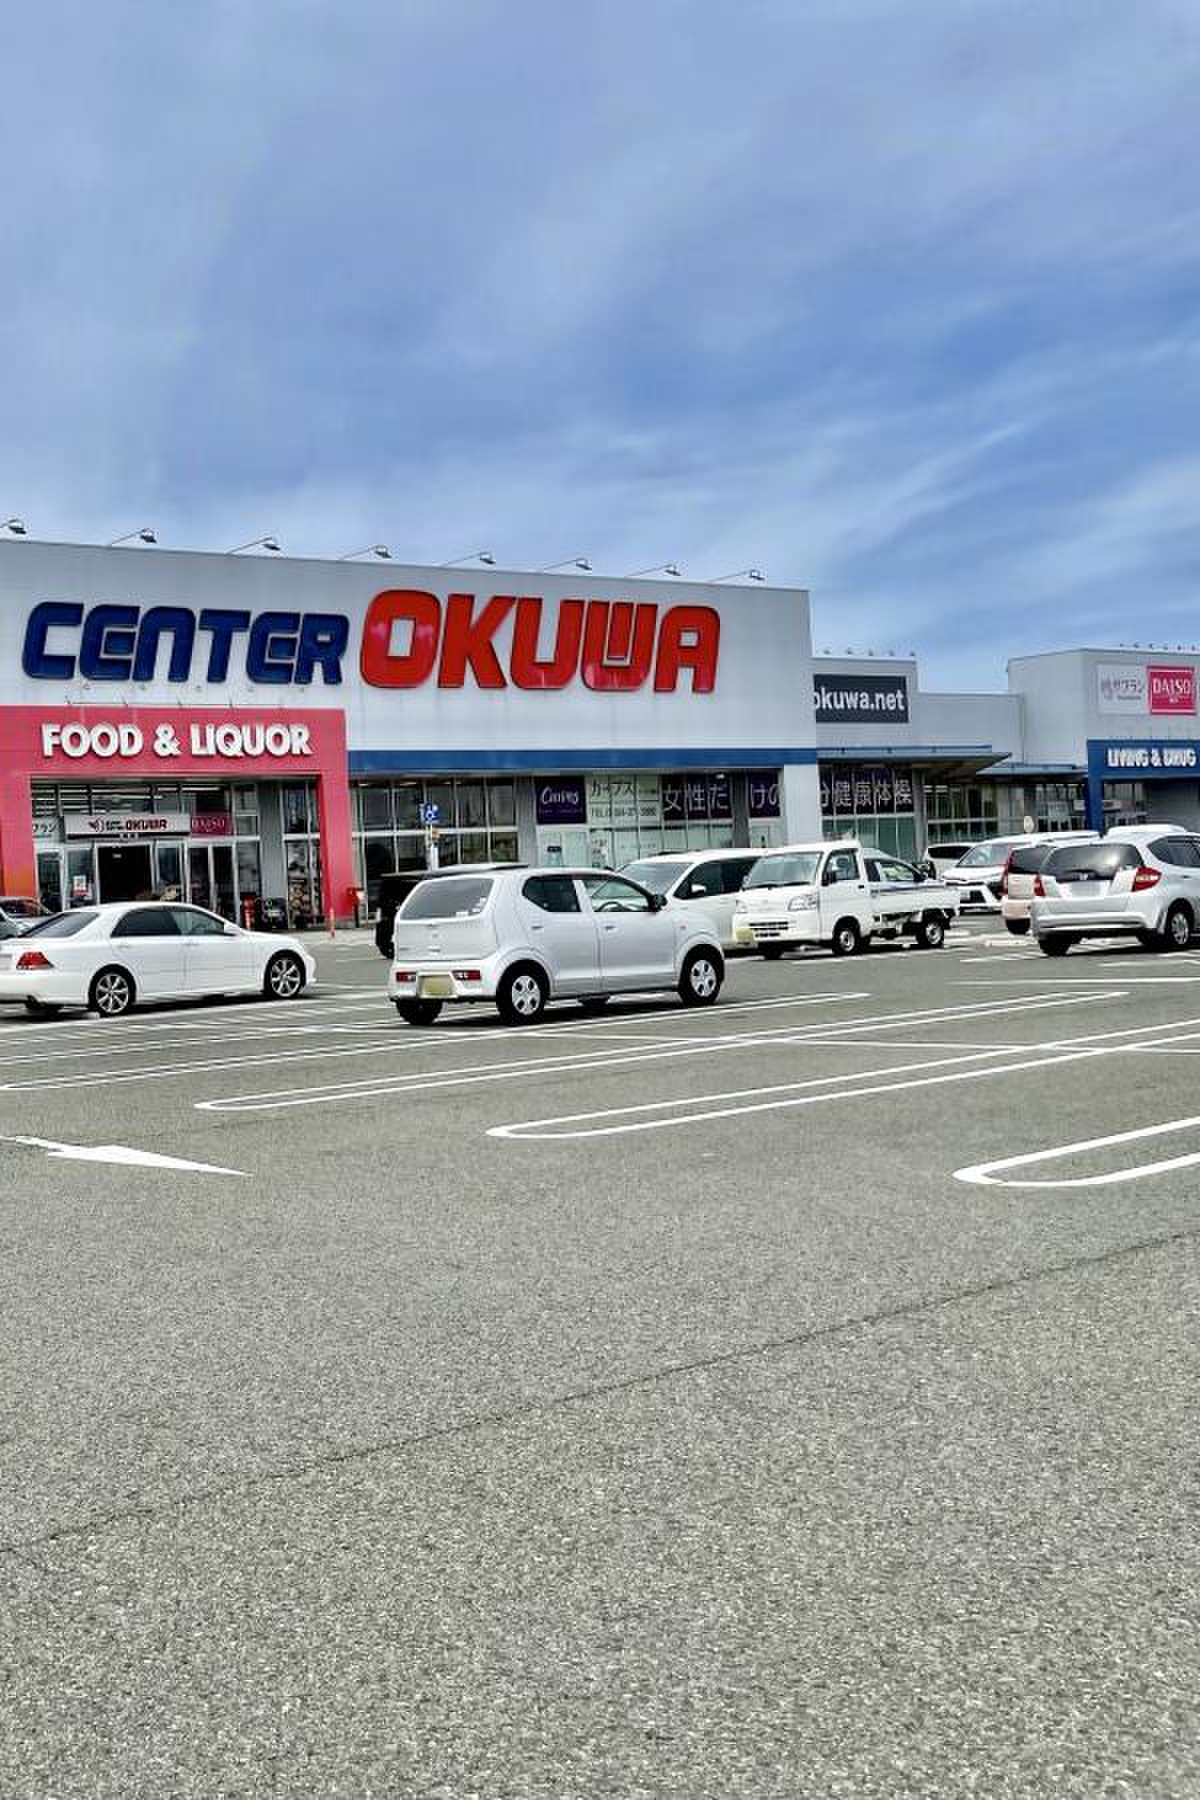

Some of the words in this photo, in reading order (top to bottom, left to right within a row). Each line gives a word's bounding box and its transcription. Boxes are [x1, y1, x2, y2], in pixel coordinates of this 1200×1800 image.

[22, 601, 349, 685] CENTER
[360, 589, 721, 694] OKUWA
[814, 686, 905, 711] okuwa.net
[1152, 678, 1191, 696] DAISO
[41, 723, 144, 757] FOOD
[153, 724, 182, 757] &
[189, 723, 313, 758] LIQUOR
